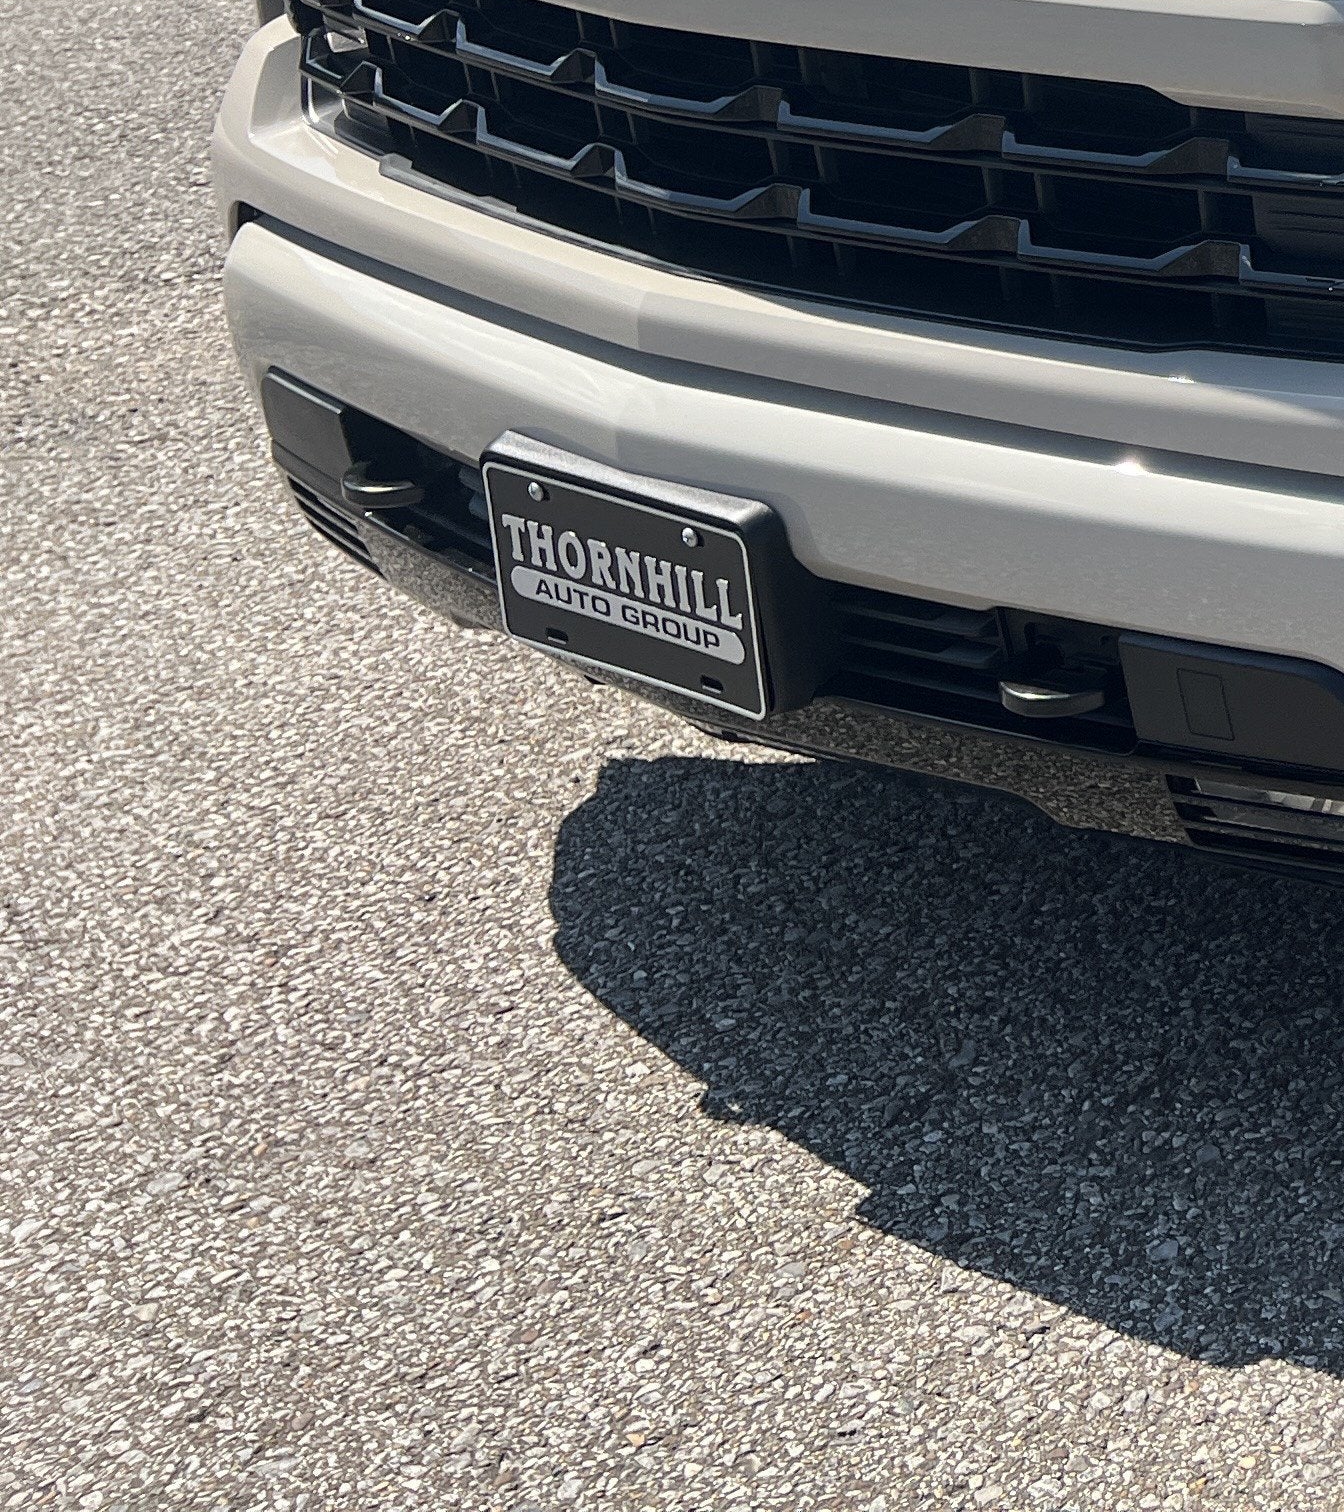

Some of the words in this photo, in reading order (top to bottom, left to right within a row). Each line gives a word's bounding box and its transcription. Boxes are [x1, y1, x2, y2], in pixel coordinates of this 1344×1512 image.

[500, 512, 745, 631] THORNHILL
[534, 577, 612, 617] AUTO
[620, 602, 721, 650] GROUP
